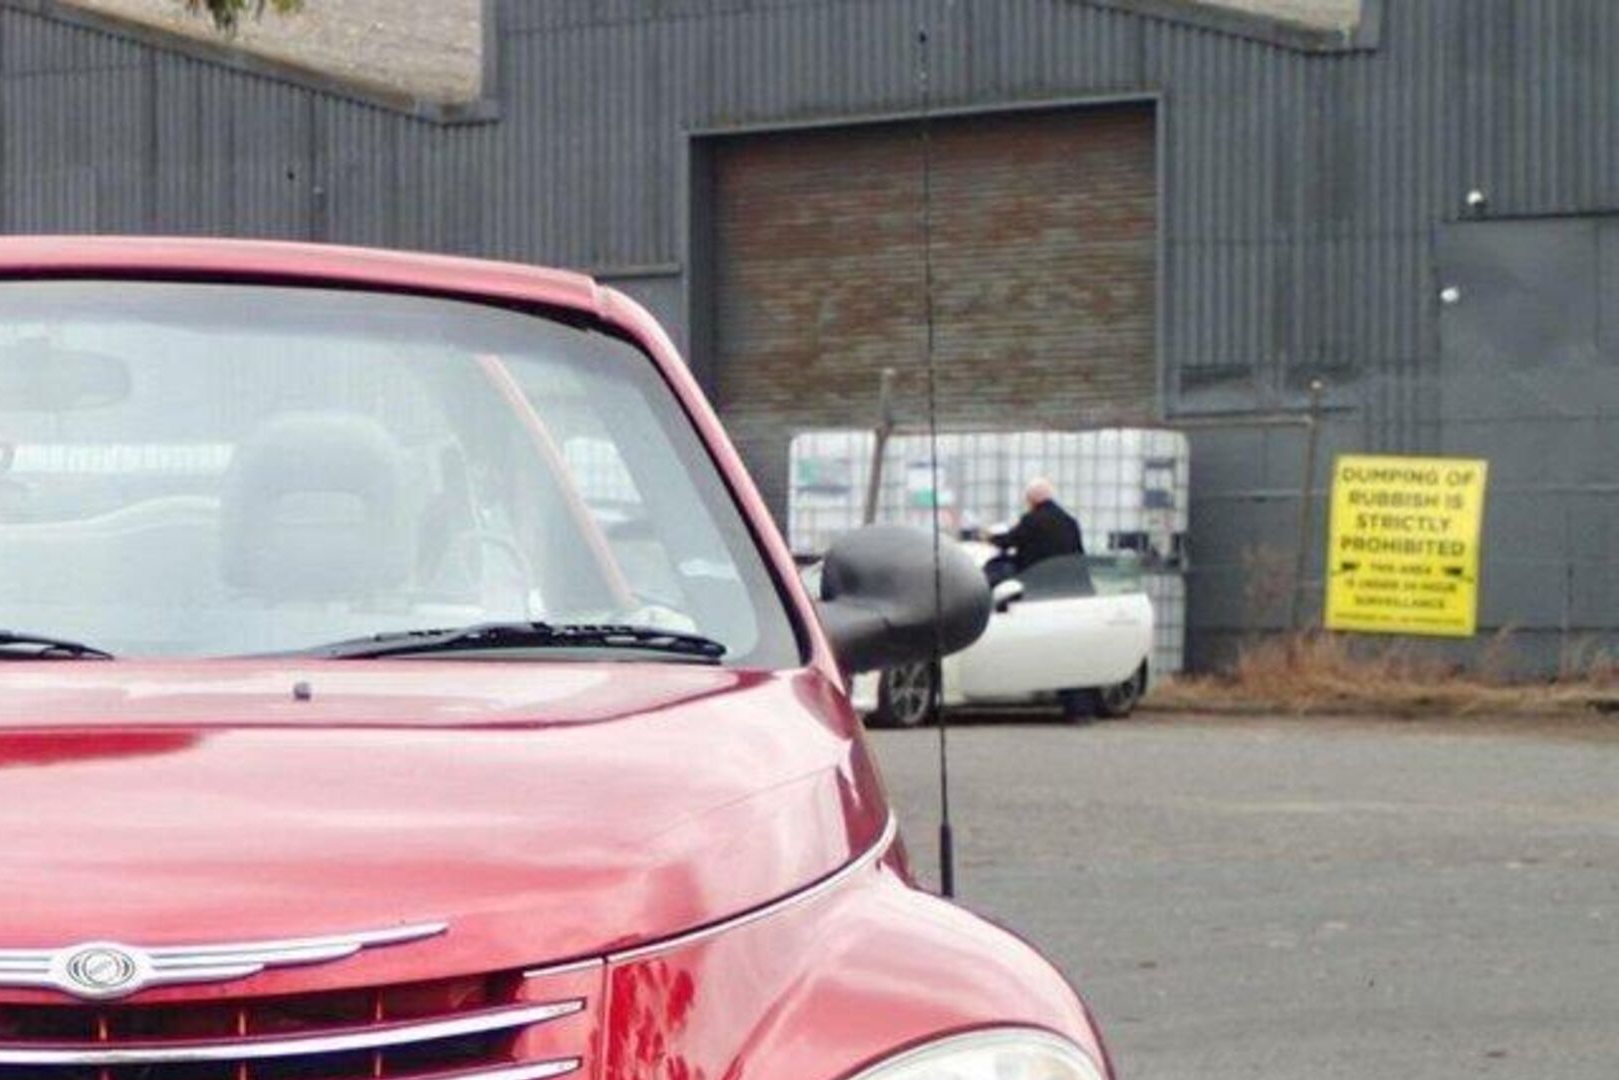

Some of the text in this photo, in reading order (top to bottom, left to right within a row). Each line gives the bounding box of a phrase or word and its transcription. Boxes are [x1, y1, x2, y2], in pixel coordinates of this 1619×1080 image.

[1342, 467, 1473, 486] DUMPING OF
[1348, 489, 1463, 509] RUBBISH IS
[1356, 512, 1451, 531] STRICTLY
[1340, 535, 1466, 557] PROHIBITED
